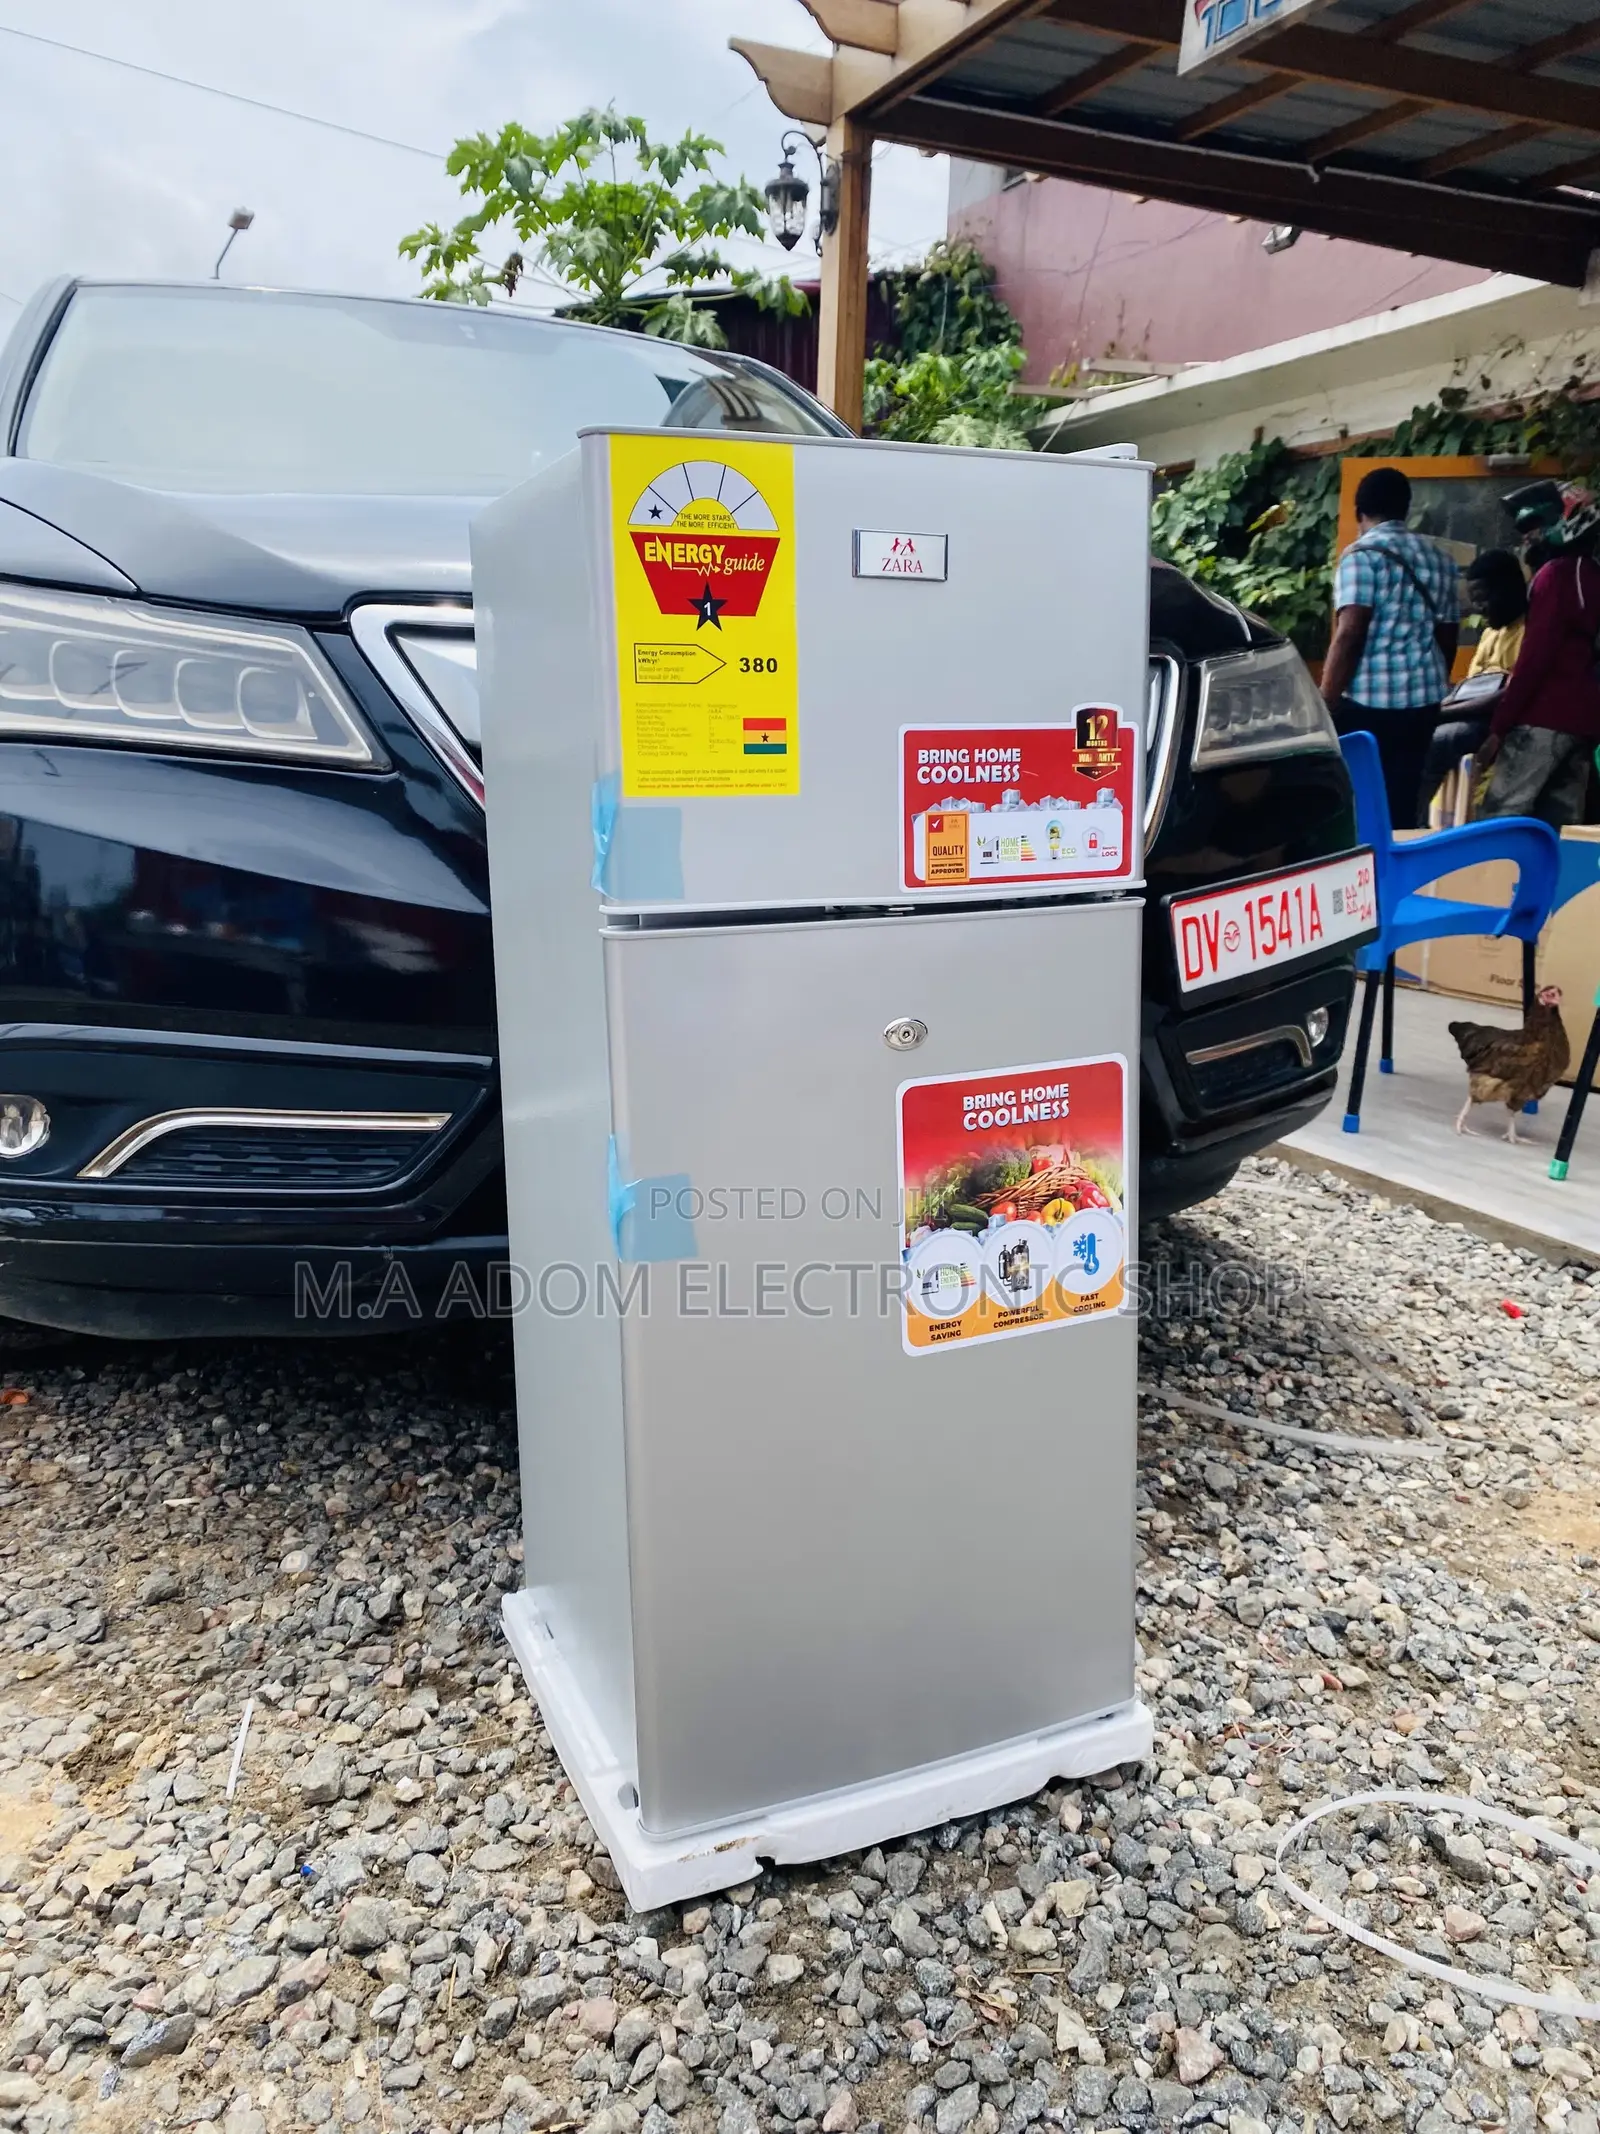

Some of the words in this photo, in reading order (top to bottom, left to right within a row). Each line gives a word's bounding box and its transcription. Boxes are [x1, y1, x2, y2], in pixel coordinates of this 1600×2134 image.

[676, 520, 687, 528] THE
[712, 514, 731, 522] STARS
[644, 535, 725, 571] ENERGY
[723, 552, 765, 575] guide
[882, 558, 924, 573] ZARA
[703, 602, 711, 616] 1
[739, 657, 778, 673] 380
[1086, 715, 1108, 740] 12
[917, 749, 969, 765] BRING
[974, 748, 1021, 764] HOME
[916, 765, 1021, 785] COOLNESS
[1000, 837, 1020, 848] HOME
[932, 845, 964, 856] QUALITY
[1061, 847, 1077, 855] ECO
[1181, 909, 1220, 982] DV
[1244, 883, 1323, 961] 1541A
[1490, 973, 1516, 986] Floor
[963, 1090, 1017, 1112] BRING
[1020, 1083, 1070, 1104] HOME
[963, 1099, 1070, 1132] COOLNESS
[1080, 1293, 1099, 1302] FAST
[997, 1305, 1039, 1318] POWERFUL
[1073, 1301, 1106, 1313] COOLING
[928, 1320, 962, 1332] ENERGY
[993, 1313, 1044, 1329] COMPRESSOR
[930, 1330, 962, 1341] SAVING
